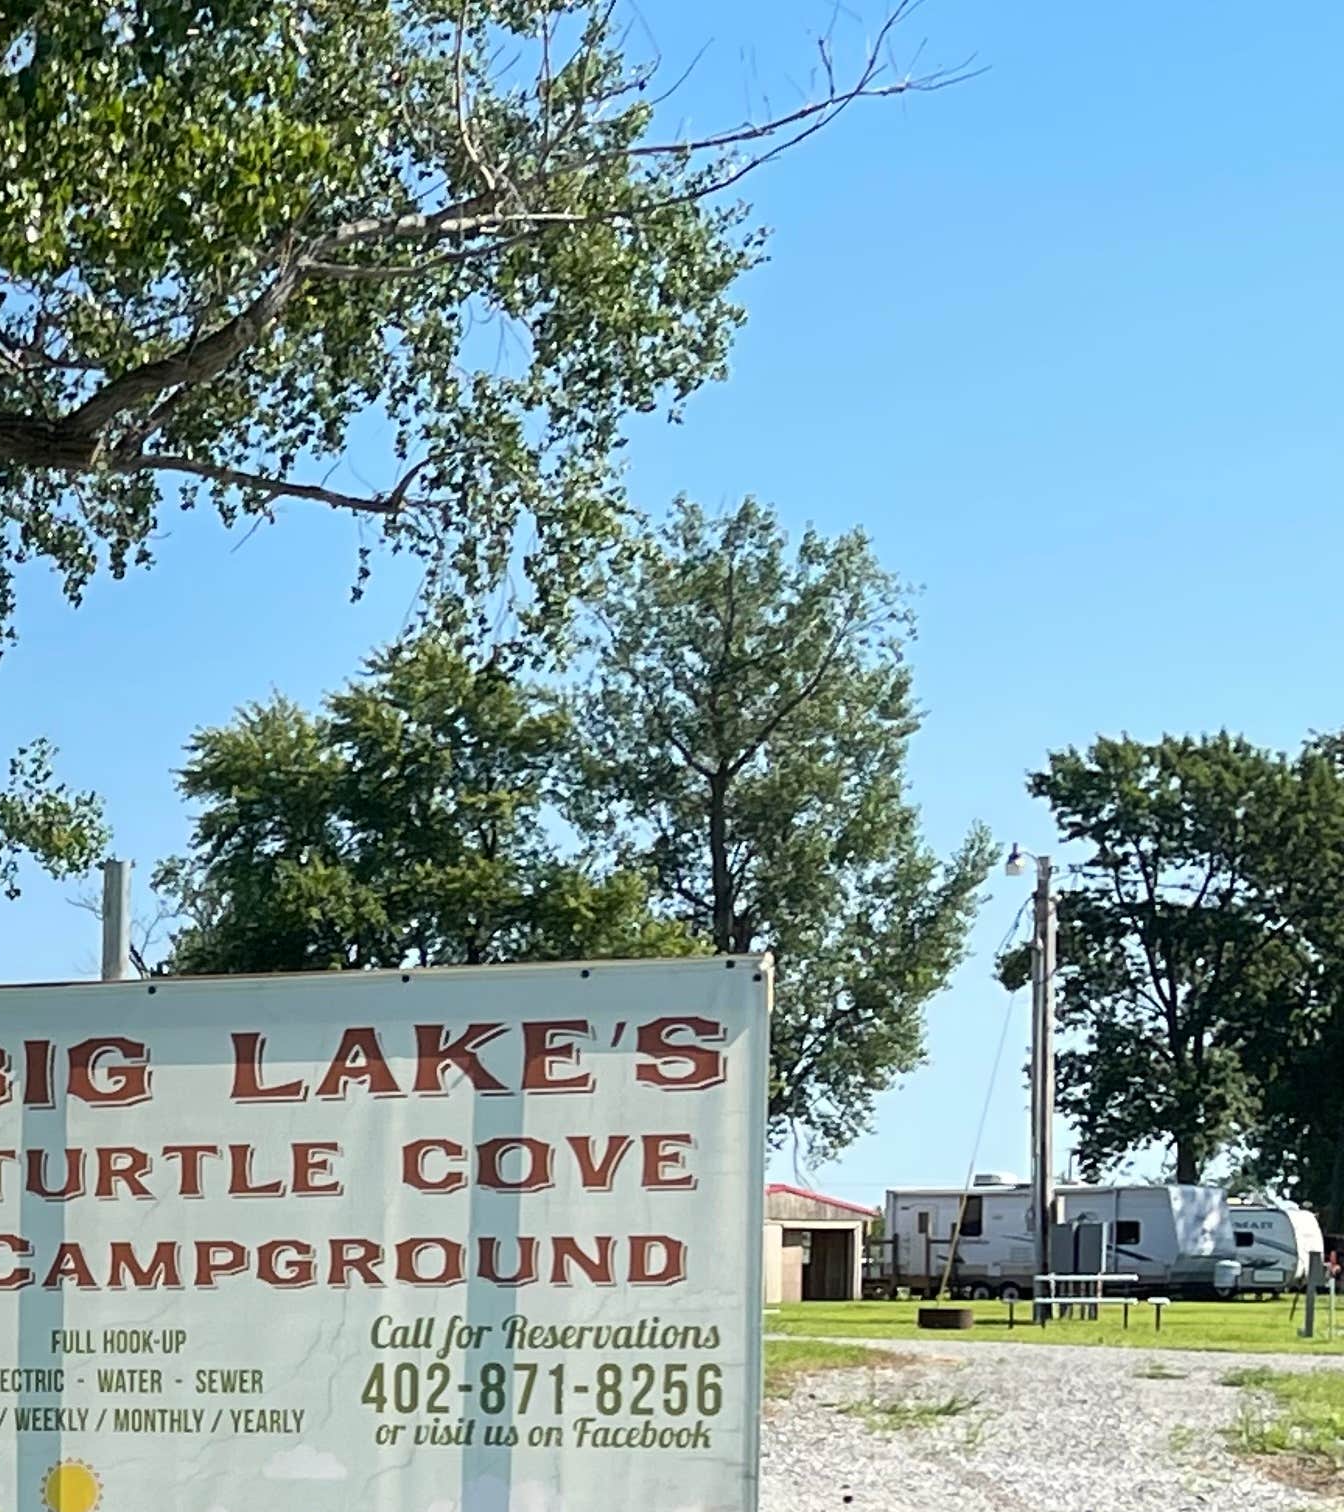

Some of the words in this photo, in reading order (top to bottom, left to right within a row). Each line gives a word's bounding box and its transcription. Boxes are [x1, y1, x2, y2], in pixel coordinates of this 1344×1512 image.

[229, 1016, 727, 1105] LAKE'S
[402, 1133, 698, 1194] COVE
[51, 1330, 96, 1354] FULL
[103, 1330, 188, 1354] HOOK-UP
[370, 1315, 436, 1350] Call
[435, 1315, 493, 1360] for
[501, 1314, 722, 1350] Reservations
[97, 1369, 163, 1393] WATER
[195, 1369, 264, 1394] SEWER
[361, 1361, 723, 1416] 402-871-8256
[14, 1407, 89, 1432] WEEKLY
[114, 1408, 205, 1433] MONTHLY
[230, 1408, 305, 1433] YEARLY
[375, 1422, 407, 1446] or
[414, 1416, 476, 1447] visit
[484, 1423, 519, 1447] us
[527, 1423, 563, 1448] on
[572, 1417, 712, 1449] Facebook
